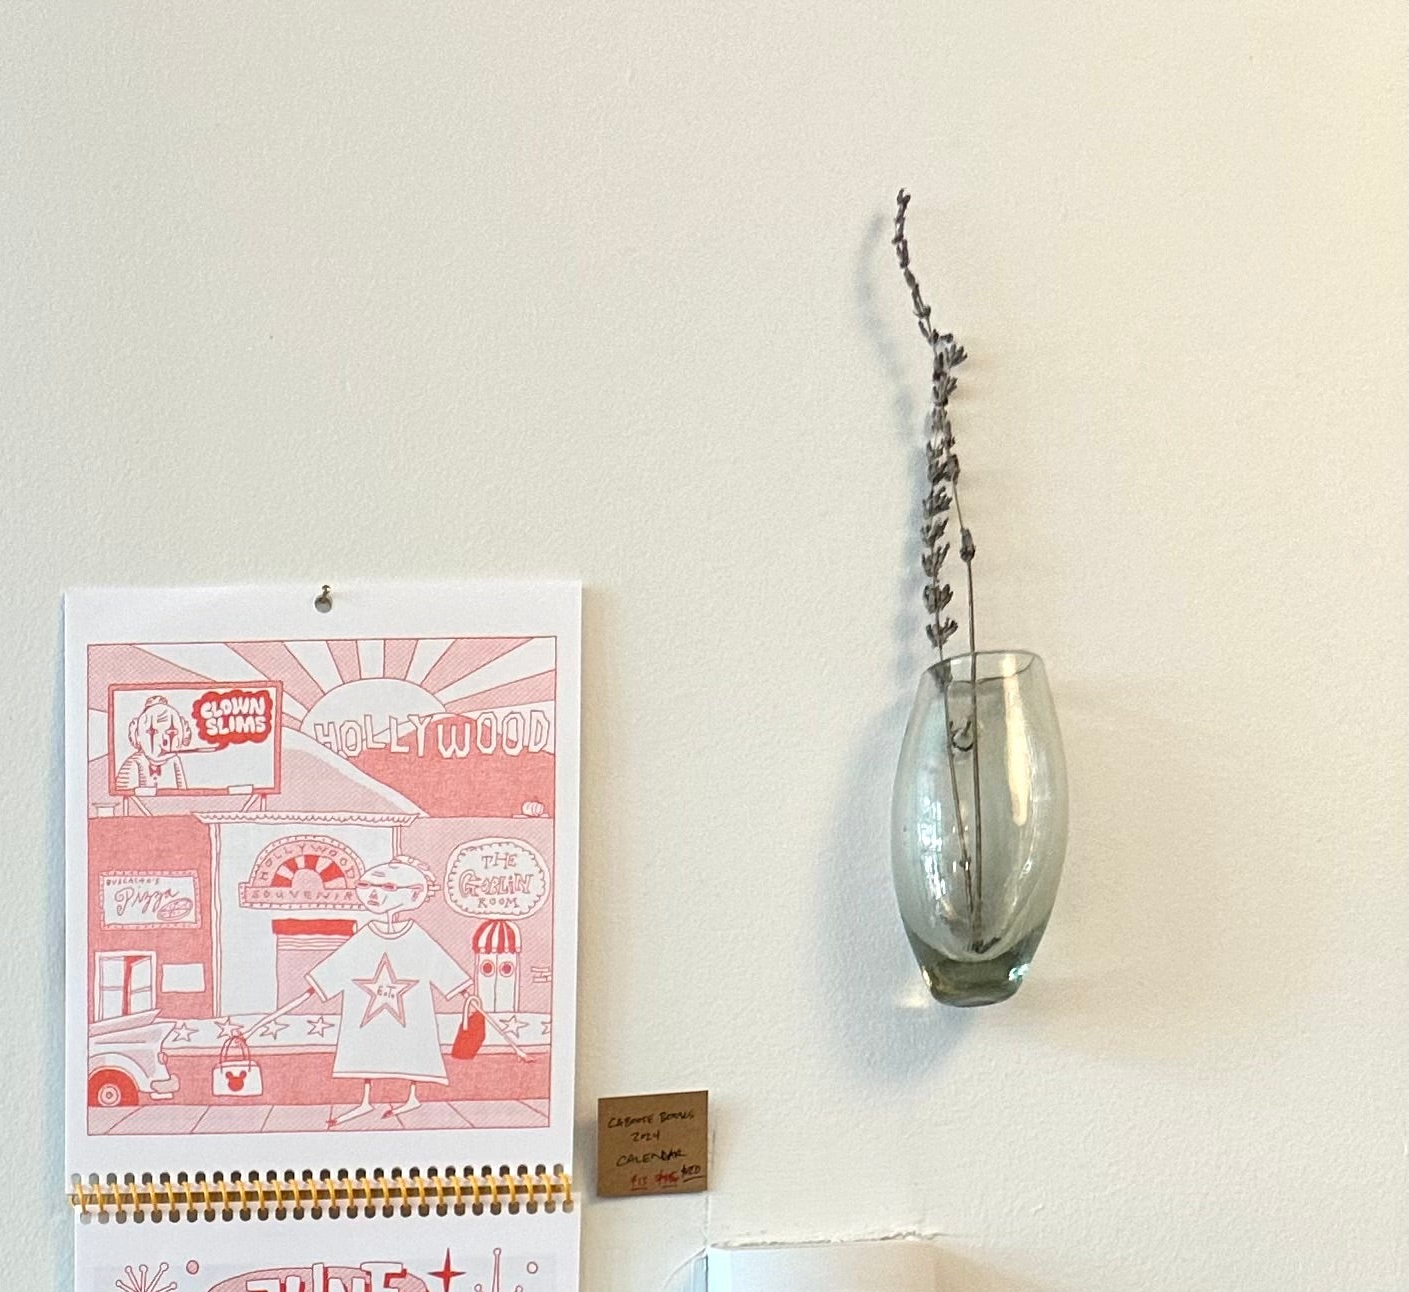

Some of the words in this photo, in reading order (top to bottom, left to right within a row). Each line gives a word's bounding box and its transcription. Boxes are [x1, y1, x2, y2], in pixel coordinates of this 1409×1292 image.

[200, 697, 266, 717] CLOWN
[205, 716, 266, 735] SLIMS
[314, 710, 550, 759] HOLLYWOOD
[260, 843, 356, 880] HOLLYWOOD
[481, 852, 518, 869] THE
[114, 885, 180, 916] Pizza
[251, 890, 354, 901] SOUVENIR
[477, 896, 518, 909] ROOM
[616, 1149, 686, 1167] CALENDAR
